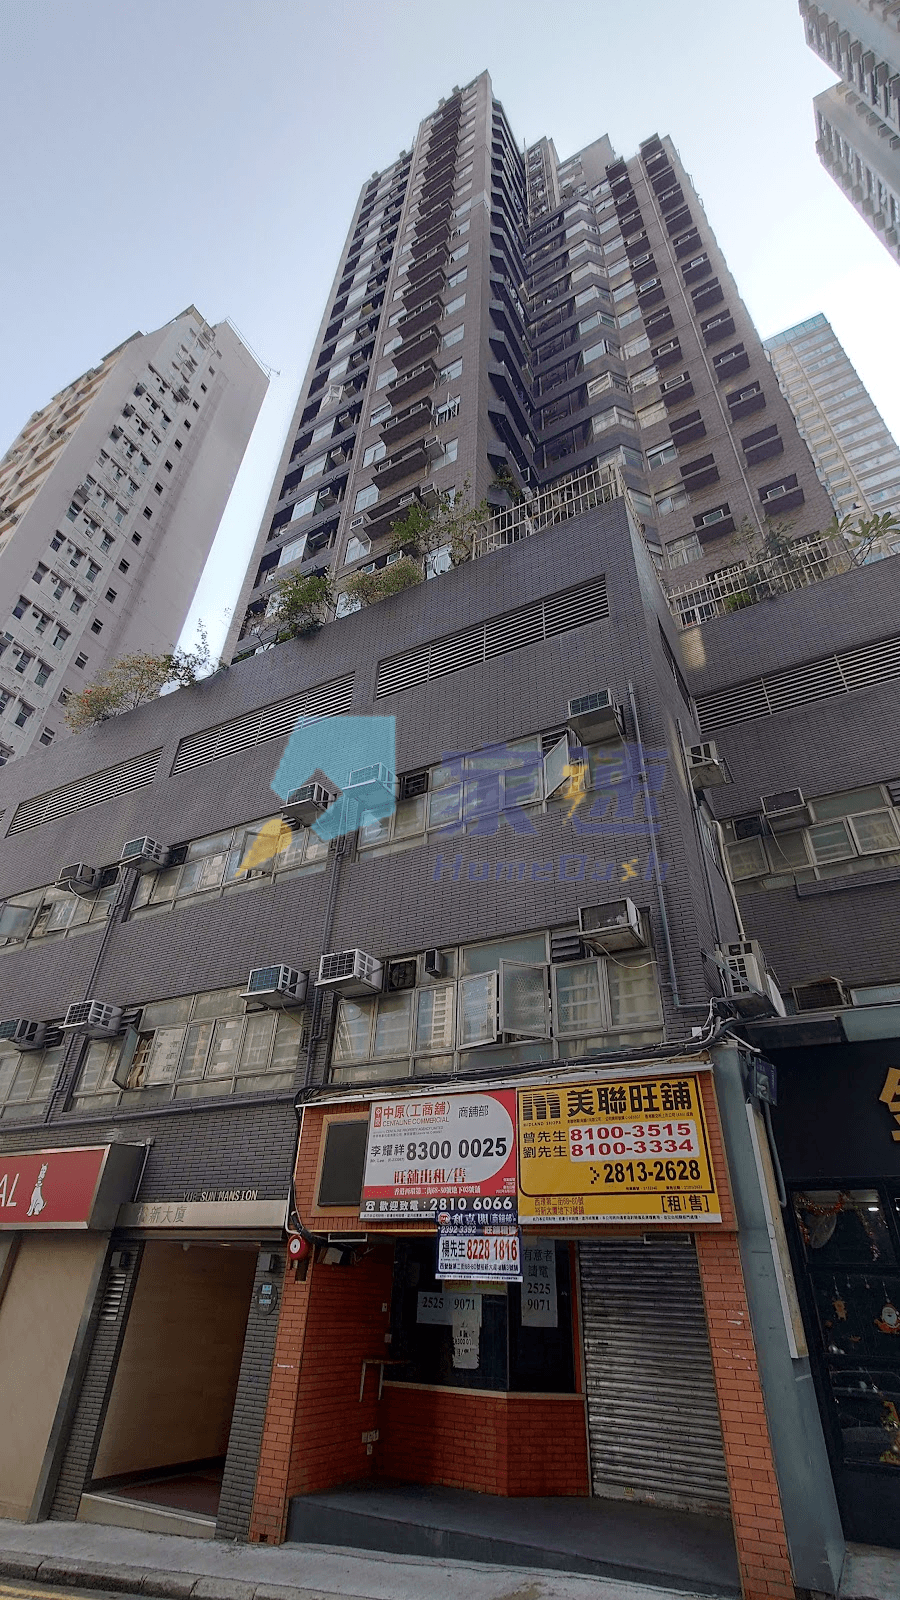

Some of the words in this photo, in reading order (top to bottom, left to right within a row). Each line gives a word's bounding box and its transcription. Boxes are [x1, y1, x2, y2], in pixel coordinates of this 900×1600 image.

[566, 1081, 693, 1118] 美聯旺舖
[523, 1130, 567, 1144] 曾先生
[570, 1123, 692, 1142] 8100-3515
[370, 1143, 405, 1158] 李耀祥
[406, 1140, 452, 1161] 8300
[458, 1137, 508, 1159] 0025
[522, 1145, 568, 1159] 劉先生
[571, 1138, 694, 1157] 8100-3334
[603, 1159, 701, 1184] 2813-2628
[200, 1191, 217, 1202] SUN
[217, 1189, 259, 1202] MANSION
[429, 1197, 467, 1211] 2810
[472, 1195, 513, 1211] 6066
[440, 1225, 458, 1234] 2392
[459, 1225, 477, 1234] 3392
[441, 1239, 466, 1258] 楊先生
[466, 1239, 491, 1260] 8228
[493, 1239, 518, 1261] 1816
[523, 1249, 554, 1262] 有意者
[527, 1282, 551, 1295] 2525
[422, 1296, 444, 1309] 2525
[454, 1298, 475, 1311] 9071
[527, 1298, 551, 1311] 9071
